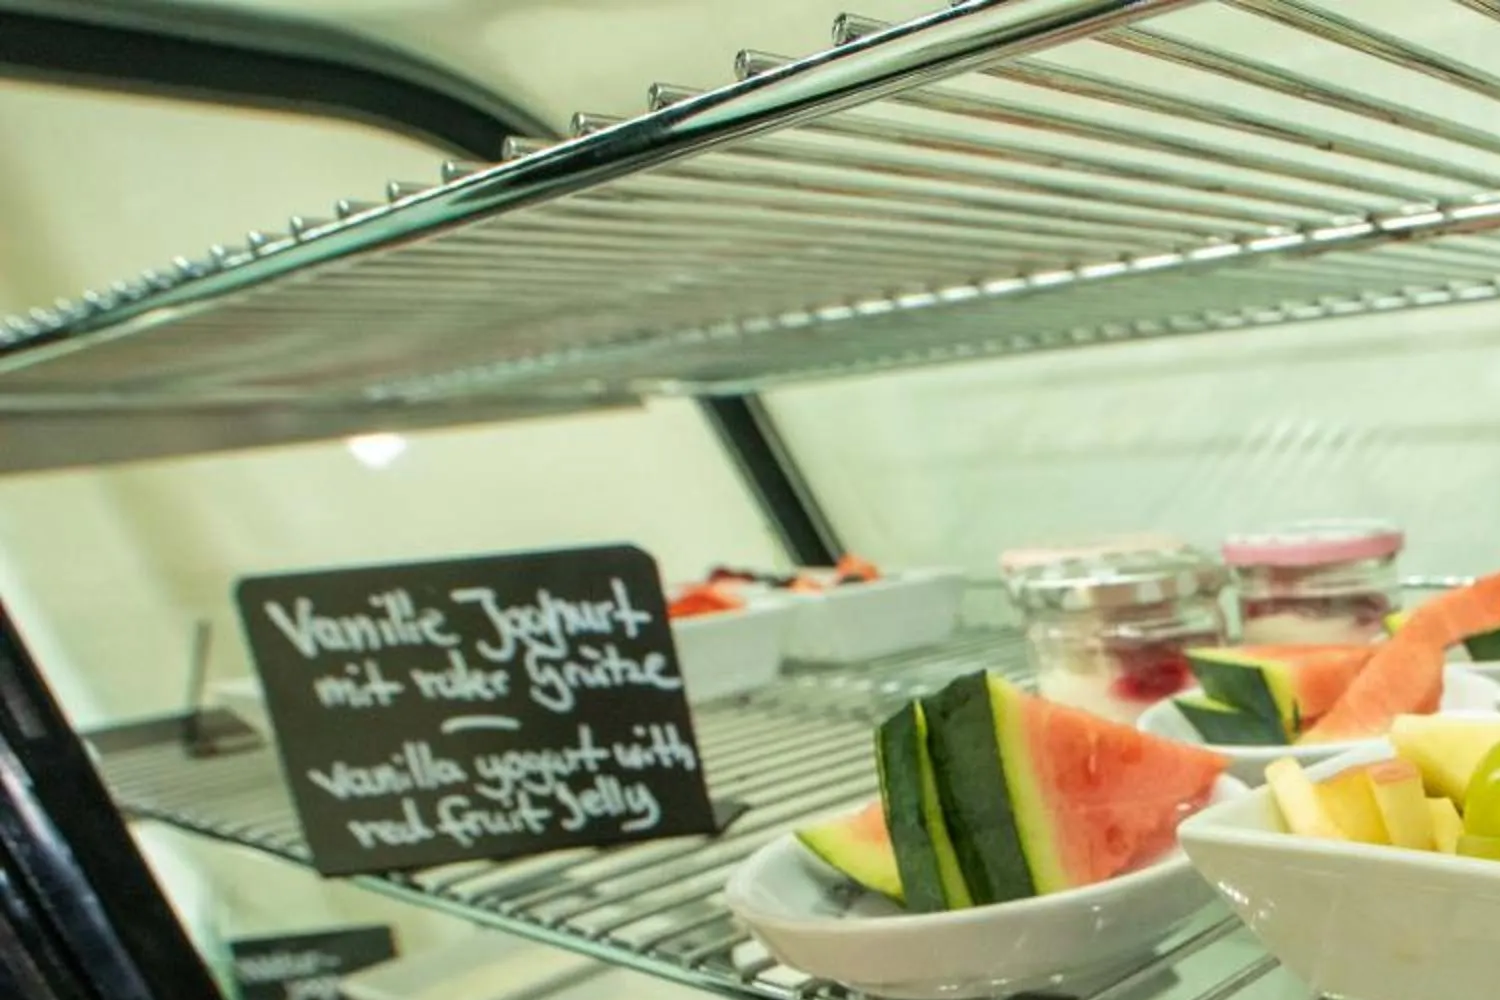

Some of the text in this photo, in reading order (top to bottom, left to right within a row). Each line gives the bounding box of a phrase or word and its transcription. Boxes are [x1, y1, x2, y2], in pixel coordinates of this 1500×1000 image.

[448, 576, 652, 663] Joghurt
[313, 658, 405, 708] mit
[473, 724, 610, 801] yogurt
[613, 723, 696, 771] with
[346, 797, 435, 849] red
[436, 790, 552, 849] fruit
